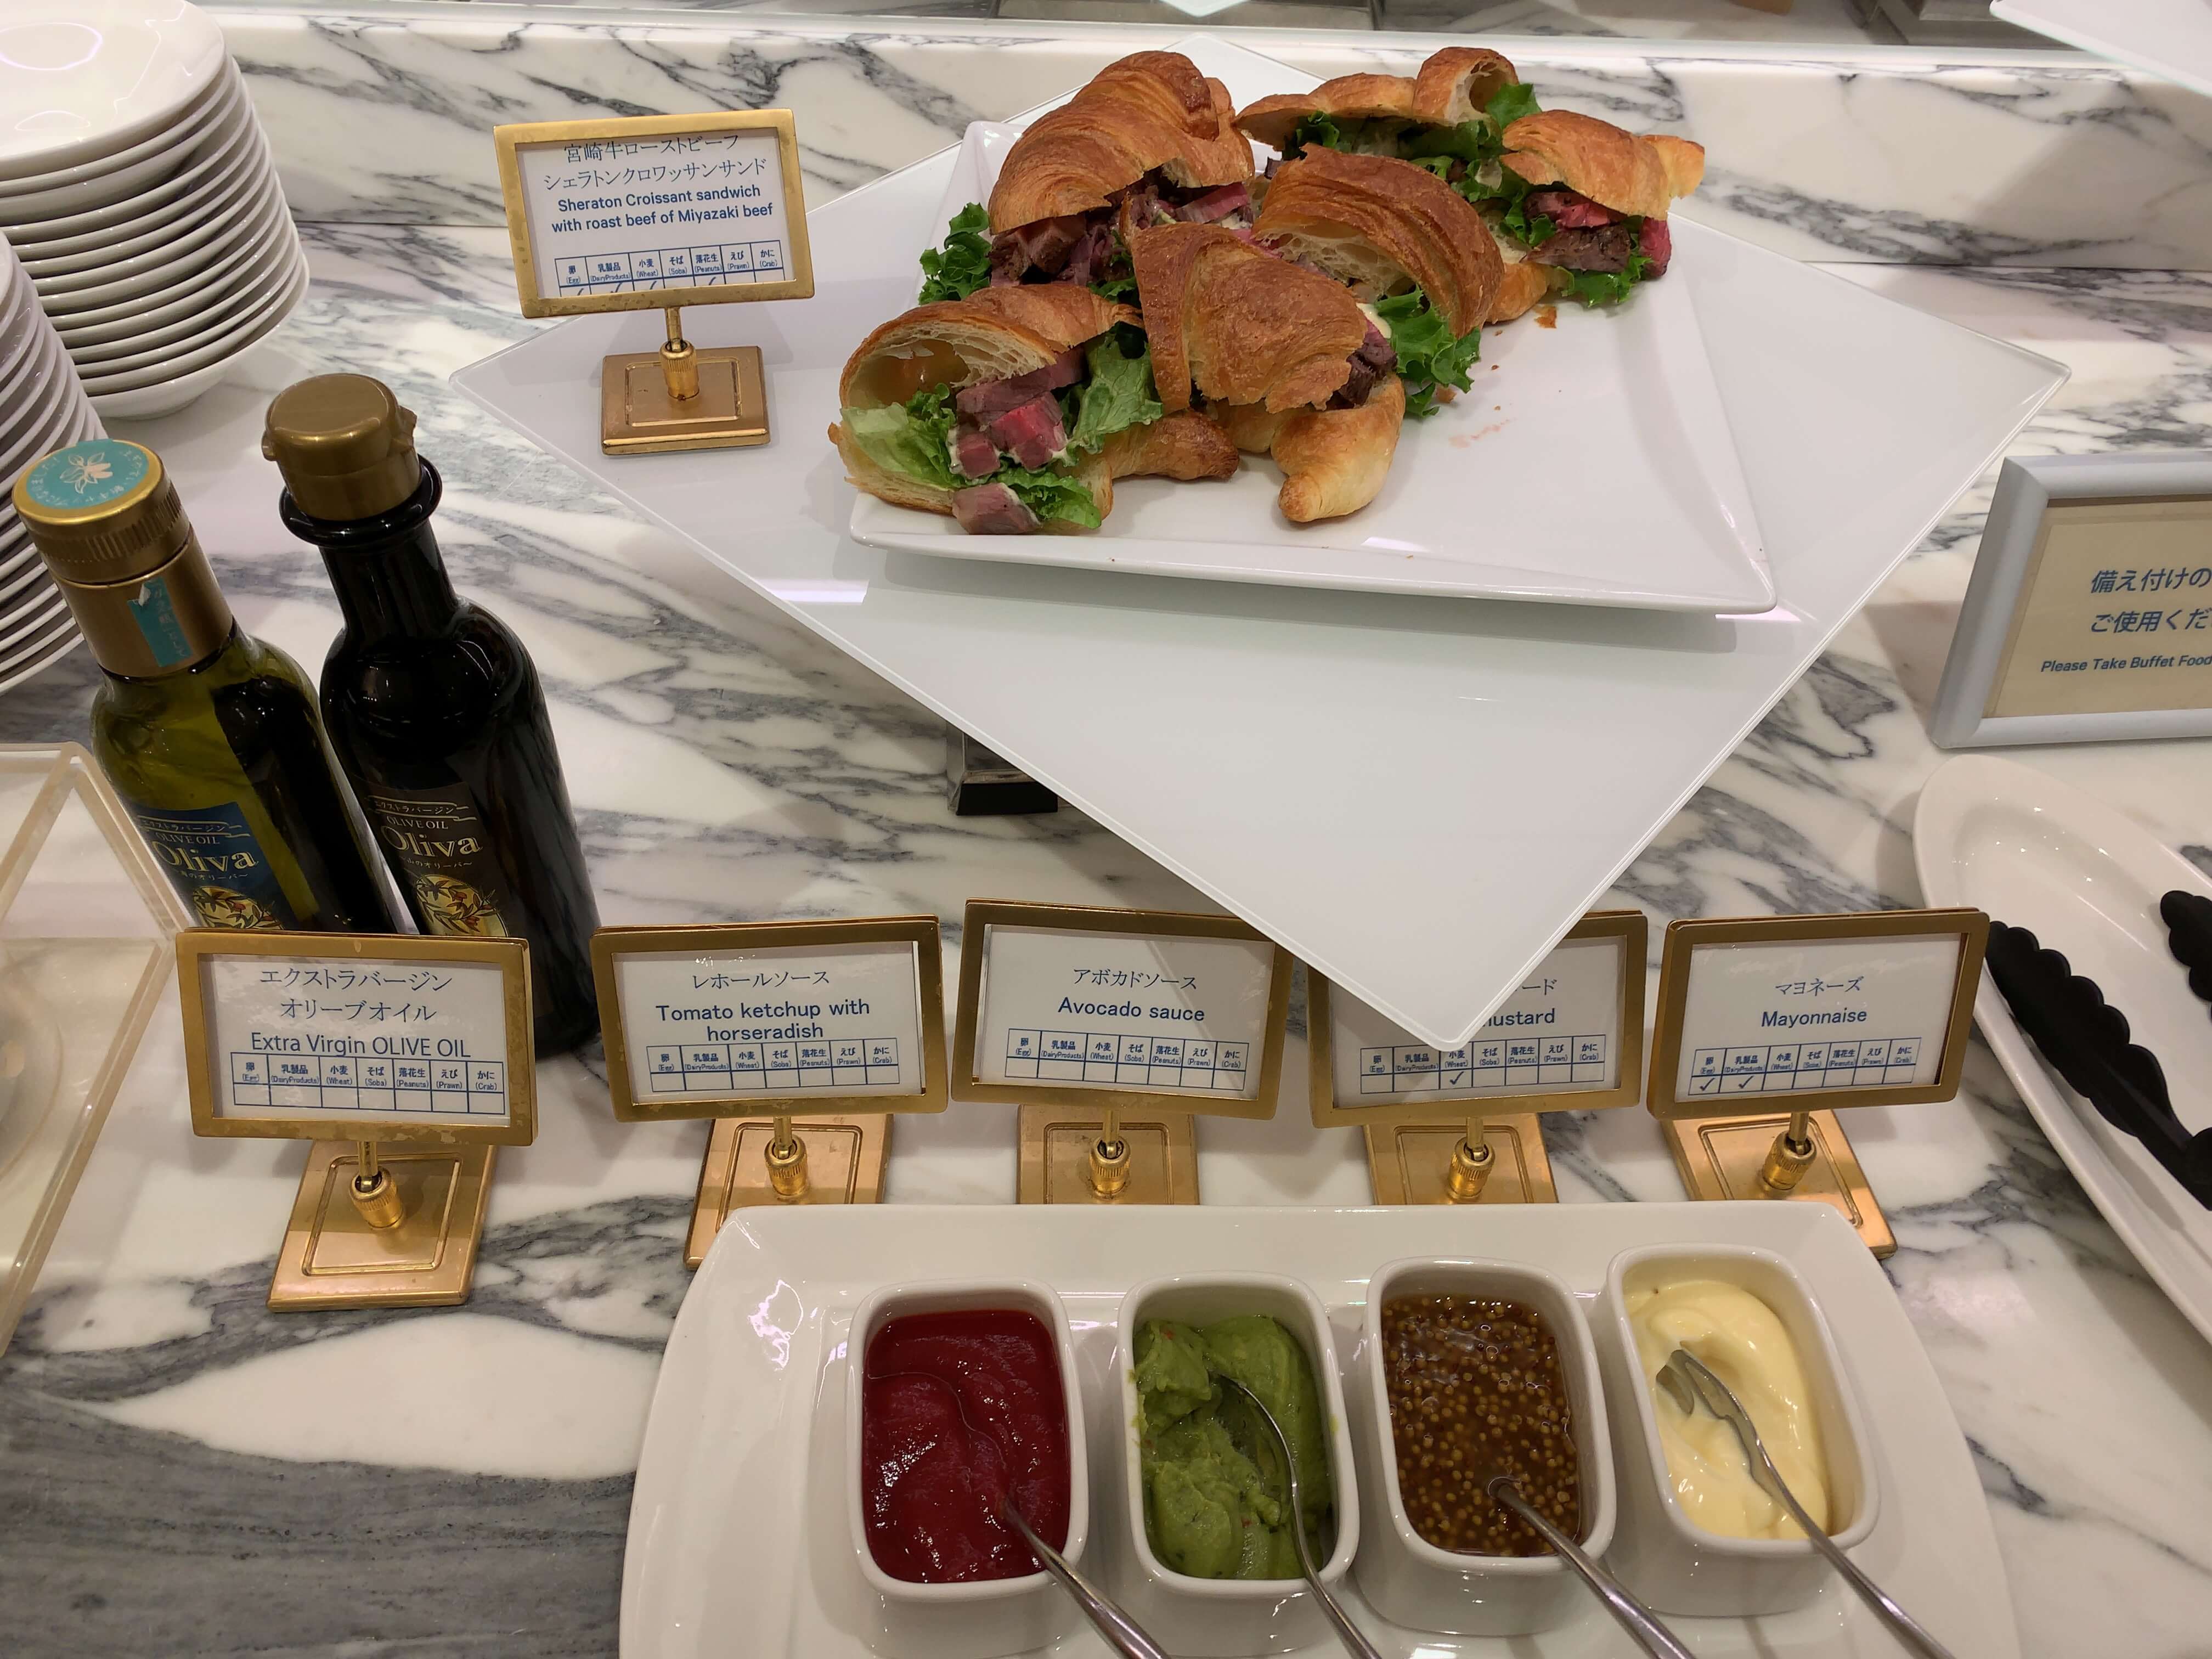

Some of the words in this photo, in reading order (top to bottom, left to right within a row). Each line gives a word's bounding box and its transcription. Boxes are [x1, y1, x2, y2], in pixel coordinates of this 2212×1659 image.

[564, 135, 738, 163] 宮崎牛ローストビーフ
[544, 158, 766, 190] シェラトンクロワッサンサンド
[558, 197, 622, 212] Sheraton
[626, 190, 692, 206] Croissant
[696, 184, 760, 201] sandwich
[552, 218, 582, 233] with
[586, 216, 622, 230] roast
[625, 211, 656, 227] beef
[661, 210, 674, 223] of
[678, 205, 738, 224] Miyazaki
[743, 202, 772, 217] beef
[568, 265, 576, 274] 卵
[598, 262, 621, 273] 乳製品
[639, 258, 654, 268] 小麦
[669, 255, 684, 266] そば
[696, 253, 719, 263] 落花生
[730, 250, 744, 260] えび
[760, 249, 775, 258] かに
[636, 268, 659, 278] (Wheat)
[669, 267, 687, 275] (Soba)
[695, 264, 723, 273] (Peanuts)
[727, 262, 749, 270] (Prawn)
[2091, 567, 2212, 593] 備え付けの
[2091, 607, 2212, 633] ご使用くだ
[2041, 660, 2087, 673] Please
[2093, 658, 2125, 670] Take
[2130, 655, 2173, 668] Buffet
[386, 816, 424, 828] OLIVE
[426, 821, 448, 829] OIL
[155, 832, 194, 844] OLIVE
[381, 826, 483, 857] Oliva
[152, 841, 259, 872] Oliva
[259, 968, 453, 991] エクストラバージン
[692, 970, 831, 989] レホールソース
[1073, 968, 1197, 990] アボカドソース
[1775, 975, 1865, 997] マヨネーズ
[280, 998, 437, 1023] オリーブオイル
[656, 1005, 733, 1022] Tomato
[741, 1002, 821, 1020] ketchup
[830, 998, 870, 1015] with
[1057, 997, 1142, 1017] Avocado
[1149, 1005, 1205, 1022] sauce
[1761, 1007, 1867, 1029] Mayonnaise
[707, 1023, 823, 1041] horseradish
[251, 1032, 301, 1052] Extra
[306, 1034, 365, 1057] Virgin
[373, 1036, 431, 1056] OLIVE
[437, 1039, 471, 1058] OIL
[693, 1053, 719, 1062] 乳製品
[739, 1051, 755, 1060] 小麦
[772, 1049, 788, 1059] そば
[802, 1048, 826, 1058] 落花生
[840, 1047, 855, 1056] えび
[874, 1047, 889, 1055] かに
[1051, 1040, 1075, 1050] 乳製品
[1095, 1042, 1111, 1051] 小麦
[1128, 1044, 1143, 1053] そば
[1155, 1045, 1179, 1056] 落花生
[1193, 1048, 1208, 1057] えび
[1224, 1050, 1240, 1059] かに
[1090, 1052, 1114, 1060] (Wheat)
[1405, 1053, 1429, 1063] 乳製品
[1449, 1050, 1465, 1059] 小麦
[1482, 1047, 1498, 1057] そば
[1511, 1046, 1535, 1056] 落花生
[1549, 1044, 1564, 1054] えび
[1582, 1043, 1597, 1052] かに
[1776, 1053, 1791, 1062] 小麦
[1807, 1050, 1822, 1059] そば
[1867, 1047, 1882, 1056] えび
[1897, 1047, 1912, 1055] かに
[281, 1064, 308, 1075] 乳製品
[330, 1065, 348, 1075] 小麦
[368, 1066, 384, 1076] そば
[399, 1068, 426, 1078] 落花生
[441, 1069, 458, 1079] えび
[477, 1070, 495, 1080] かに
[326, 1077, 352, 1085] (Wheat)
[365, 1078, 387, 1087] (Soba)
[396, 1080, 429, 1088] (Peanuts)
[436, 1081, 462, 1090] (Prawn)
[476, 1082, 497, 1091] (Crab)
